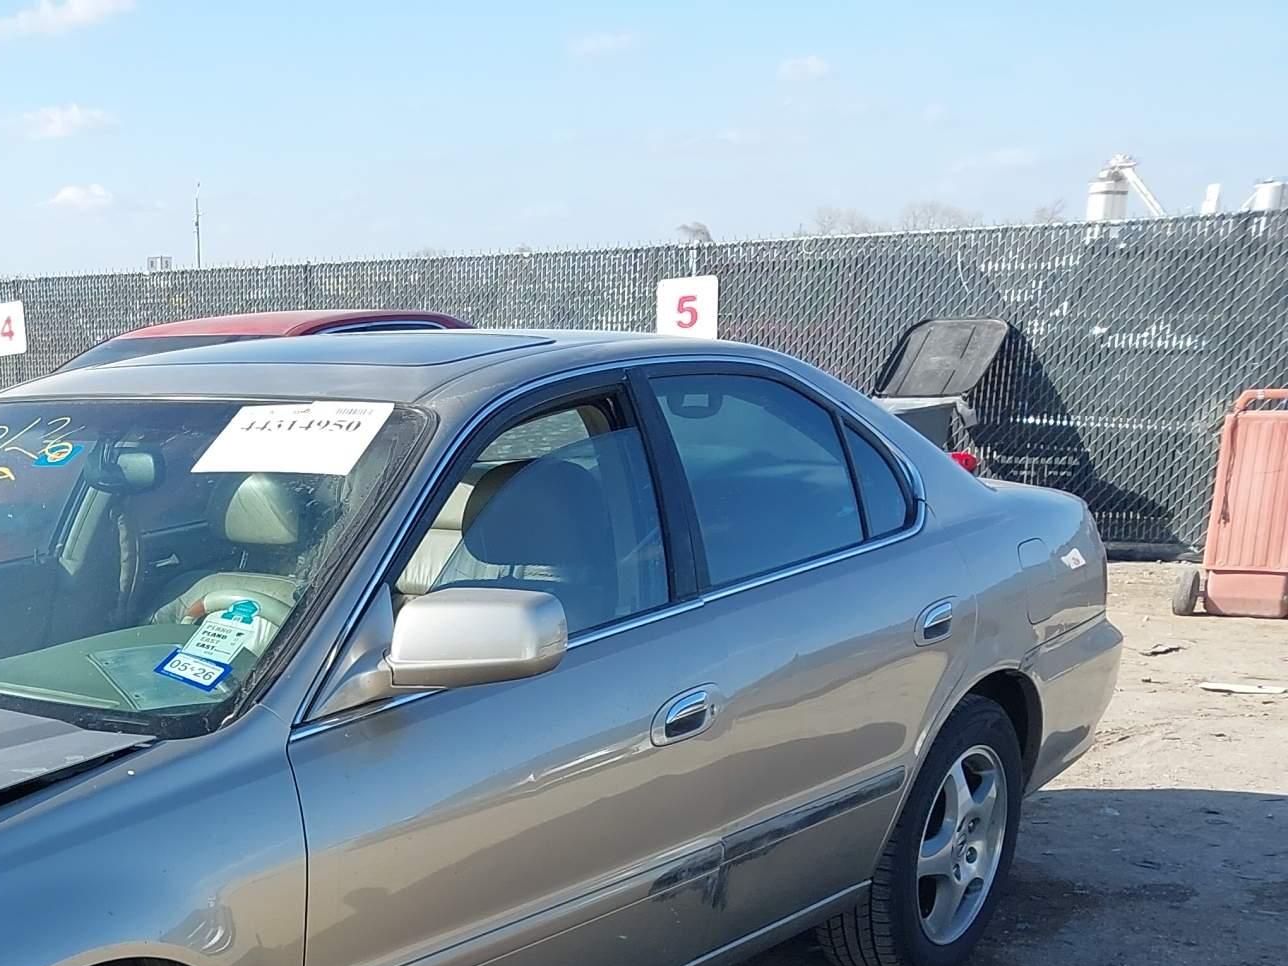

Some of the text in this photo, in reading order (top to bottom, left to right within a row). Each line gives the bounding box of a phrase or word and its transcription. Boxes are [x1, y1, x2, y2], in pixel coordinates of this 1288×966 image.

[677, 295, 698, 329] 5
[0, 315, 15, 341] 4
[201, 630, 228, 640] PLANO
[195, 642, 216, 651] EAST
[169, 659, 191, 672] 05
[192, 667, 215, 681] 26
